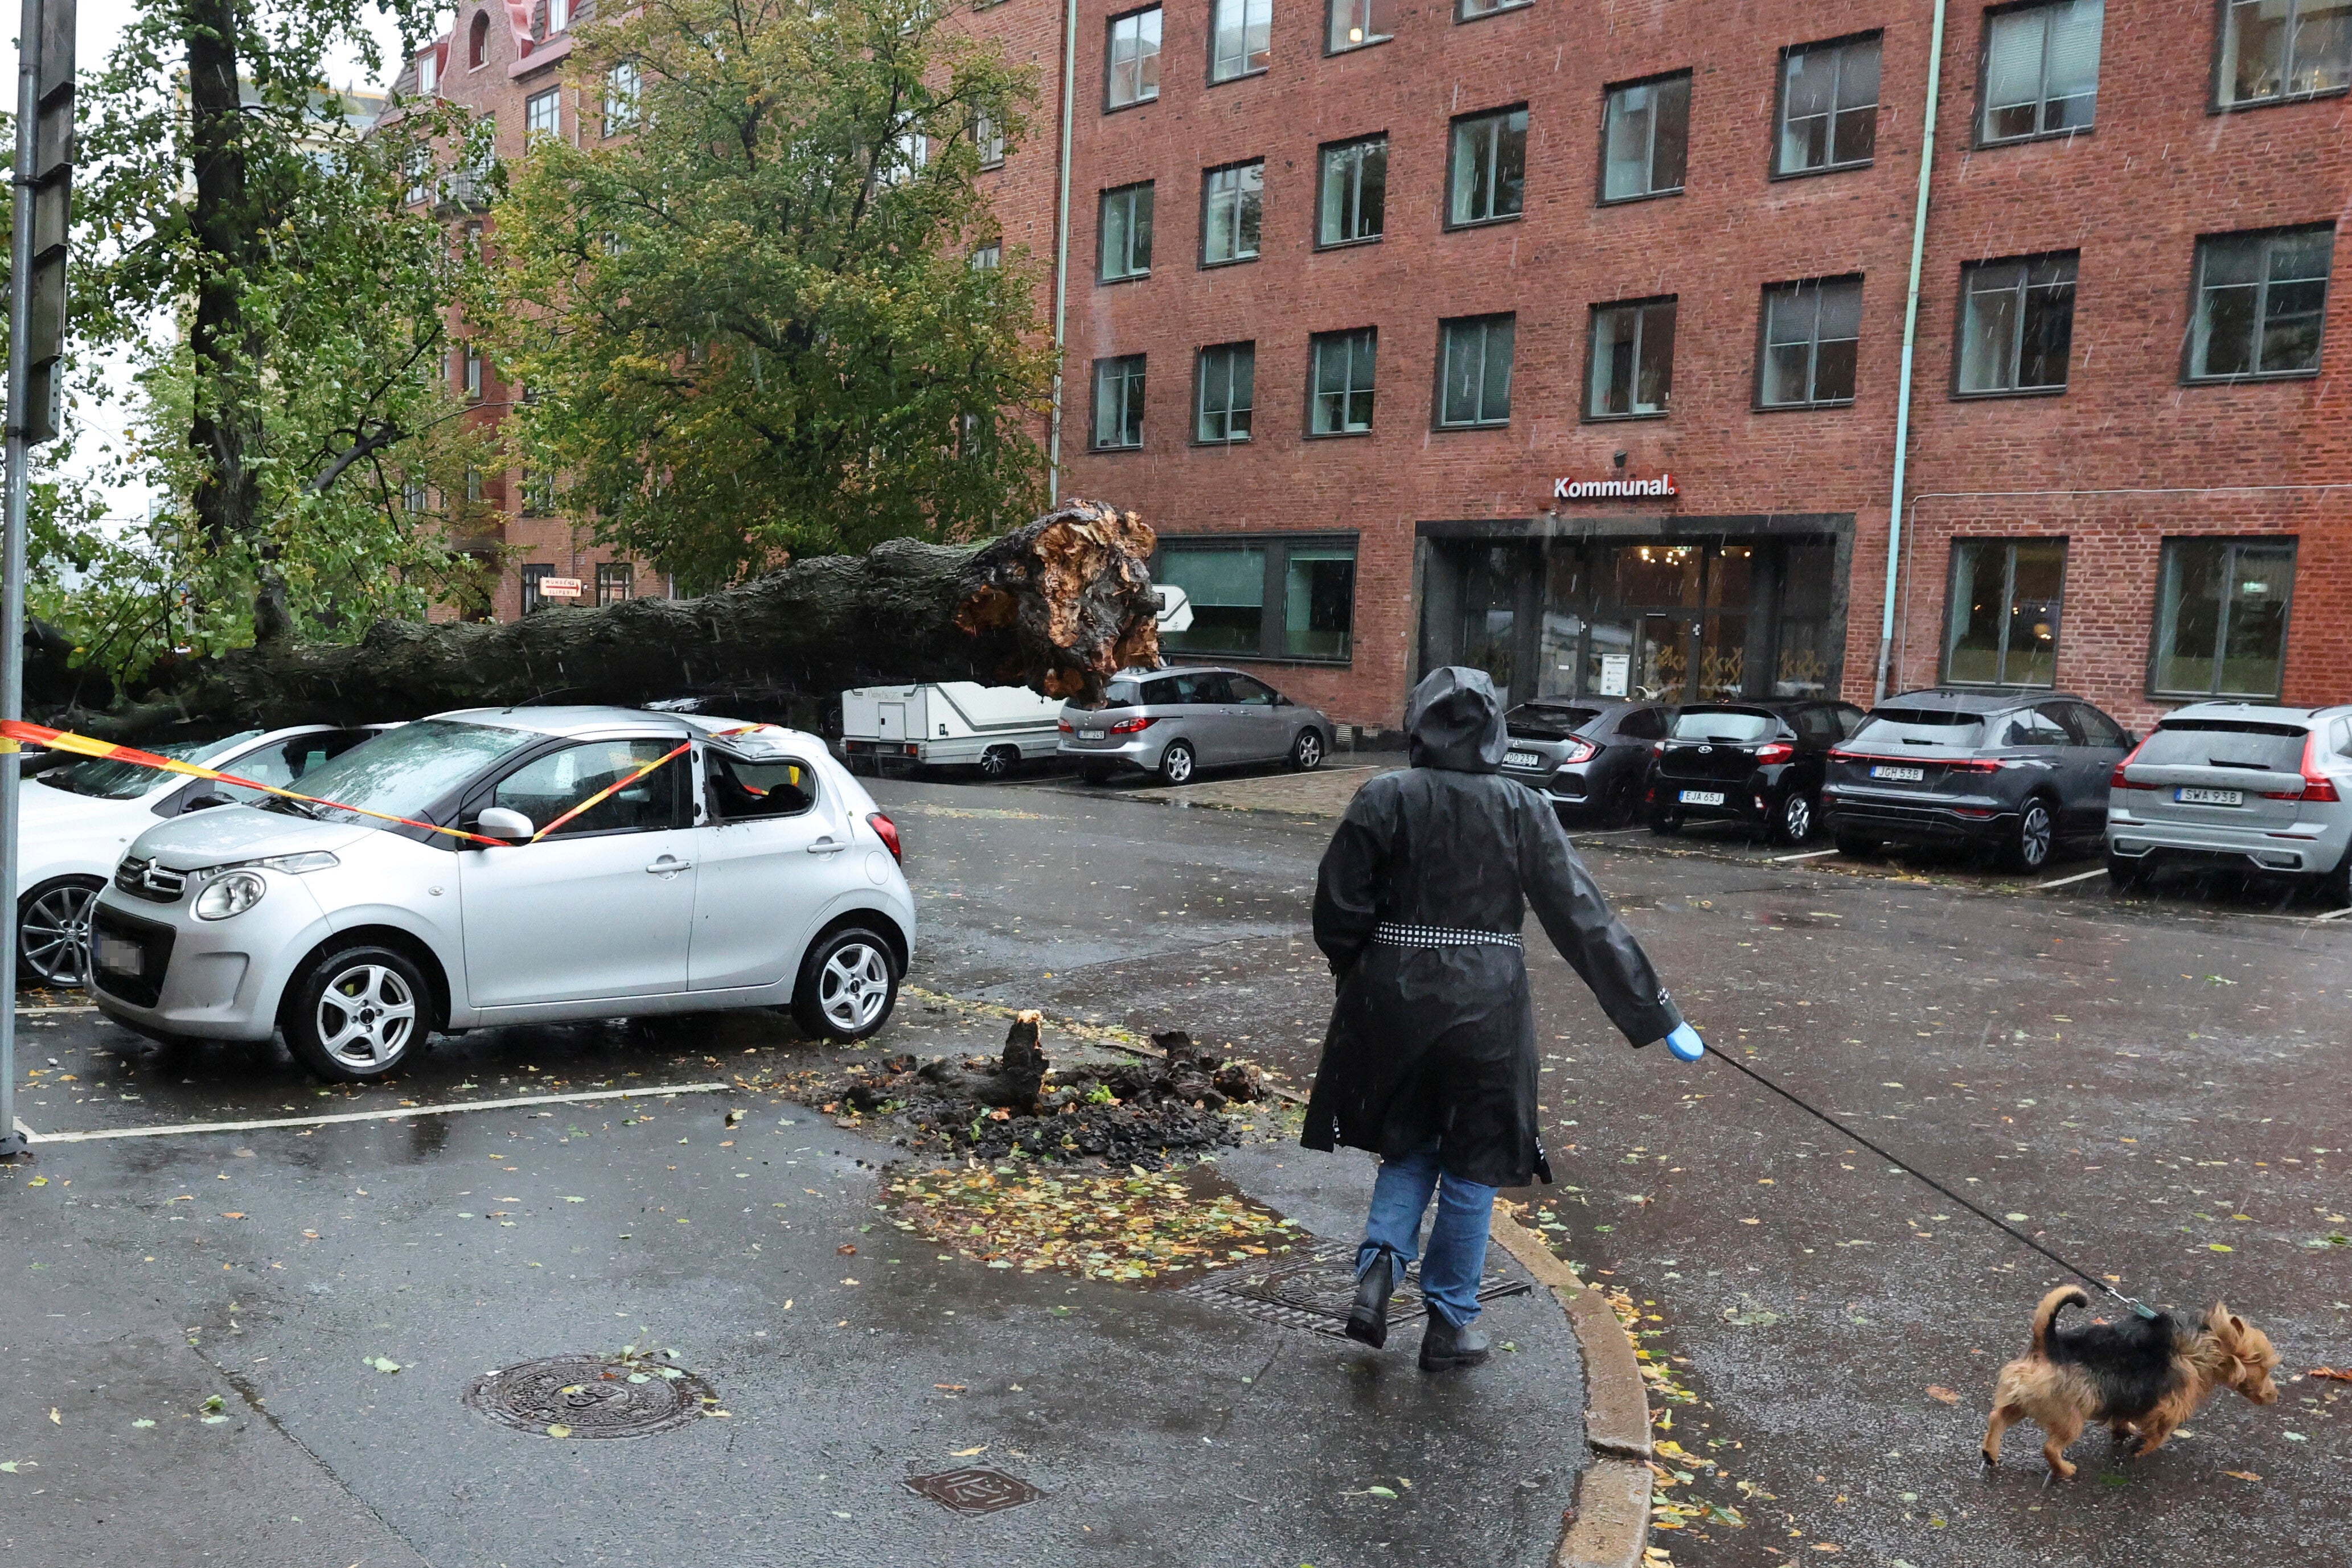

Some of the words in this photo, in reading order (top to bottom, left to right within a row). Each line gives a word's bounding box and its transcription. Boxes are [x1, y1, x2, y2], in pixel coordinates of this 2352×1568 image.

[1520, 754, 1536, 763] 237
[1879, 767, 1898, 778] JGH
[1899, 769, 1919, 779] 53B
[1686, 792, 1701, 801] EJA
[1704, 793, 1721, 802] 65J
[2186, 790, 2209, 802] SWA
[2213, 791, 2236, 803] 93B
